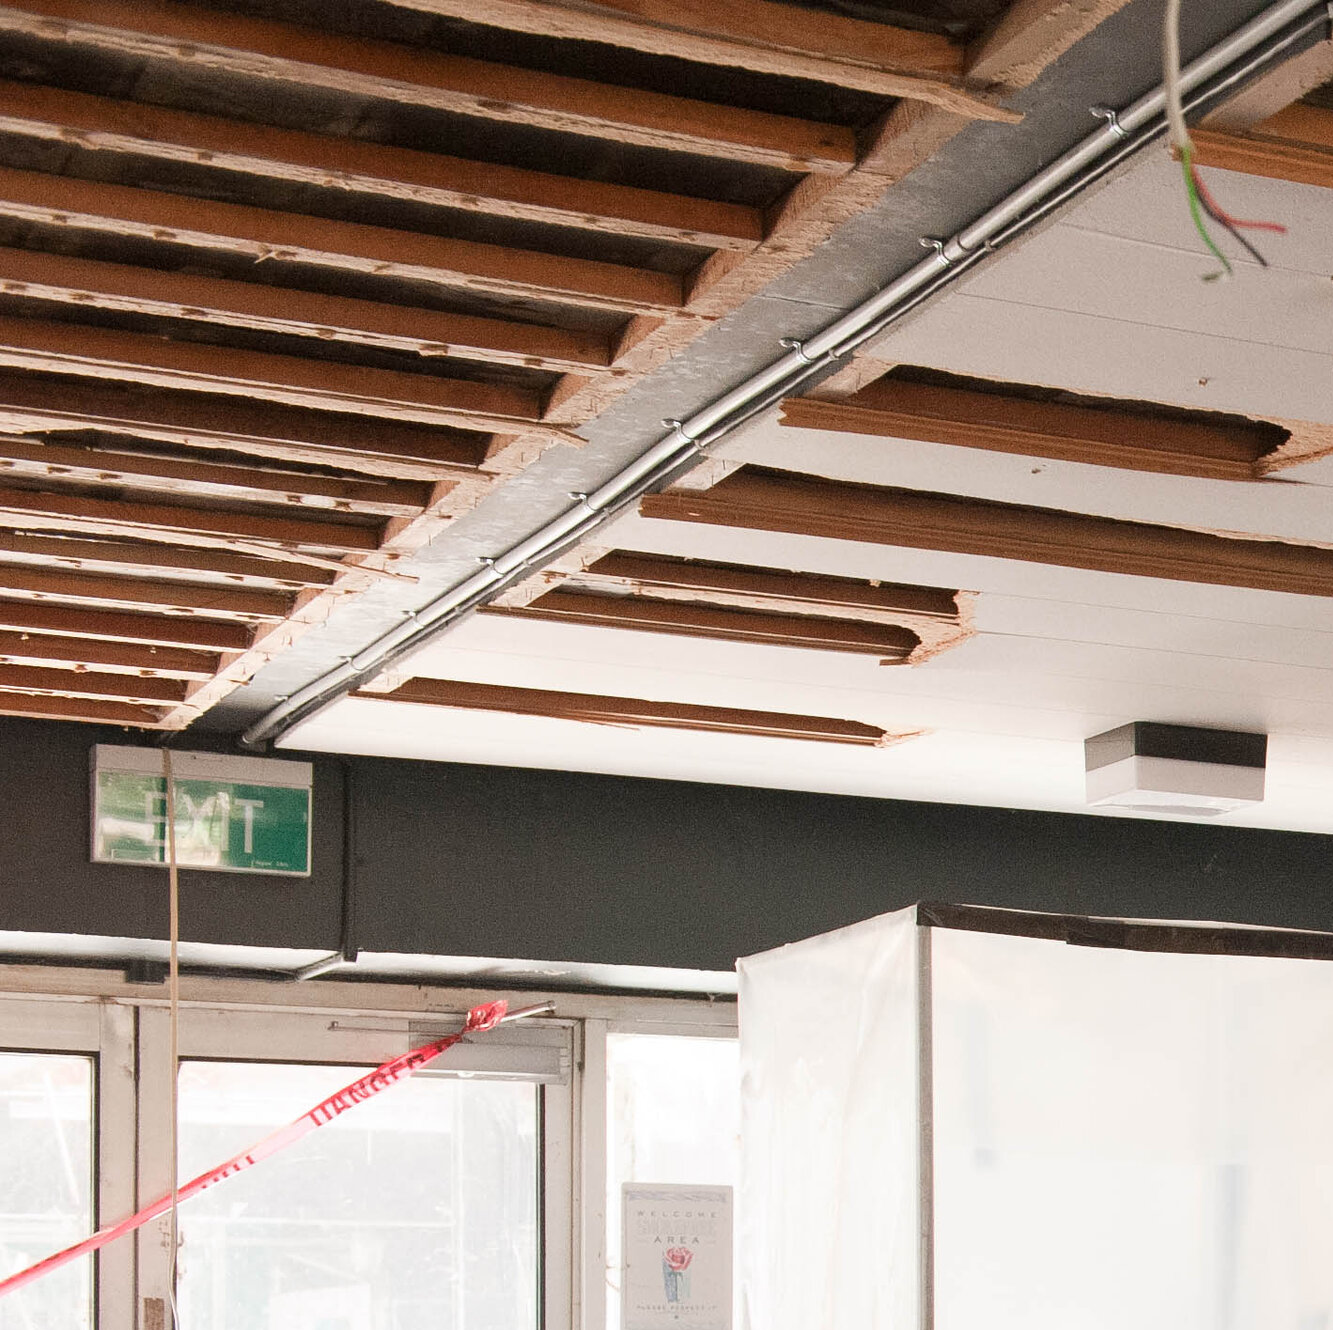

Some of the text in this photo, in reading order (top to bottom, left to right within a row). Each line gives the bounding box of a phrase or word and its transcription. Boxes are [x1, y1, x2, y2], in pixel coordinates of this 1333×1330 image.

[144, 791, 265, 854] EXIT
[637, 1210, 718, 1219] WELCOME
[654, 1235, 700, 1244] AREA
